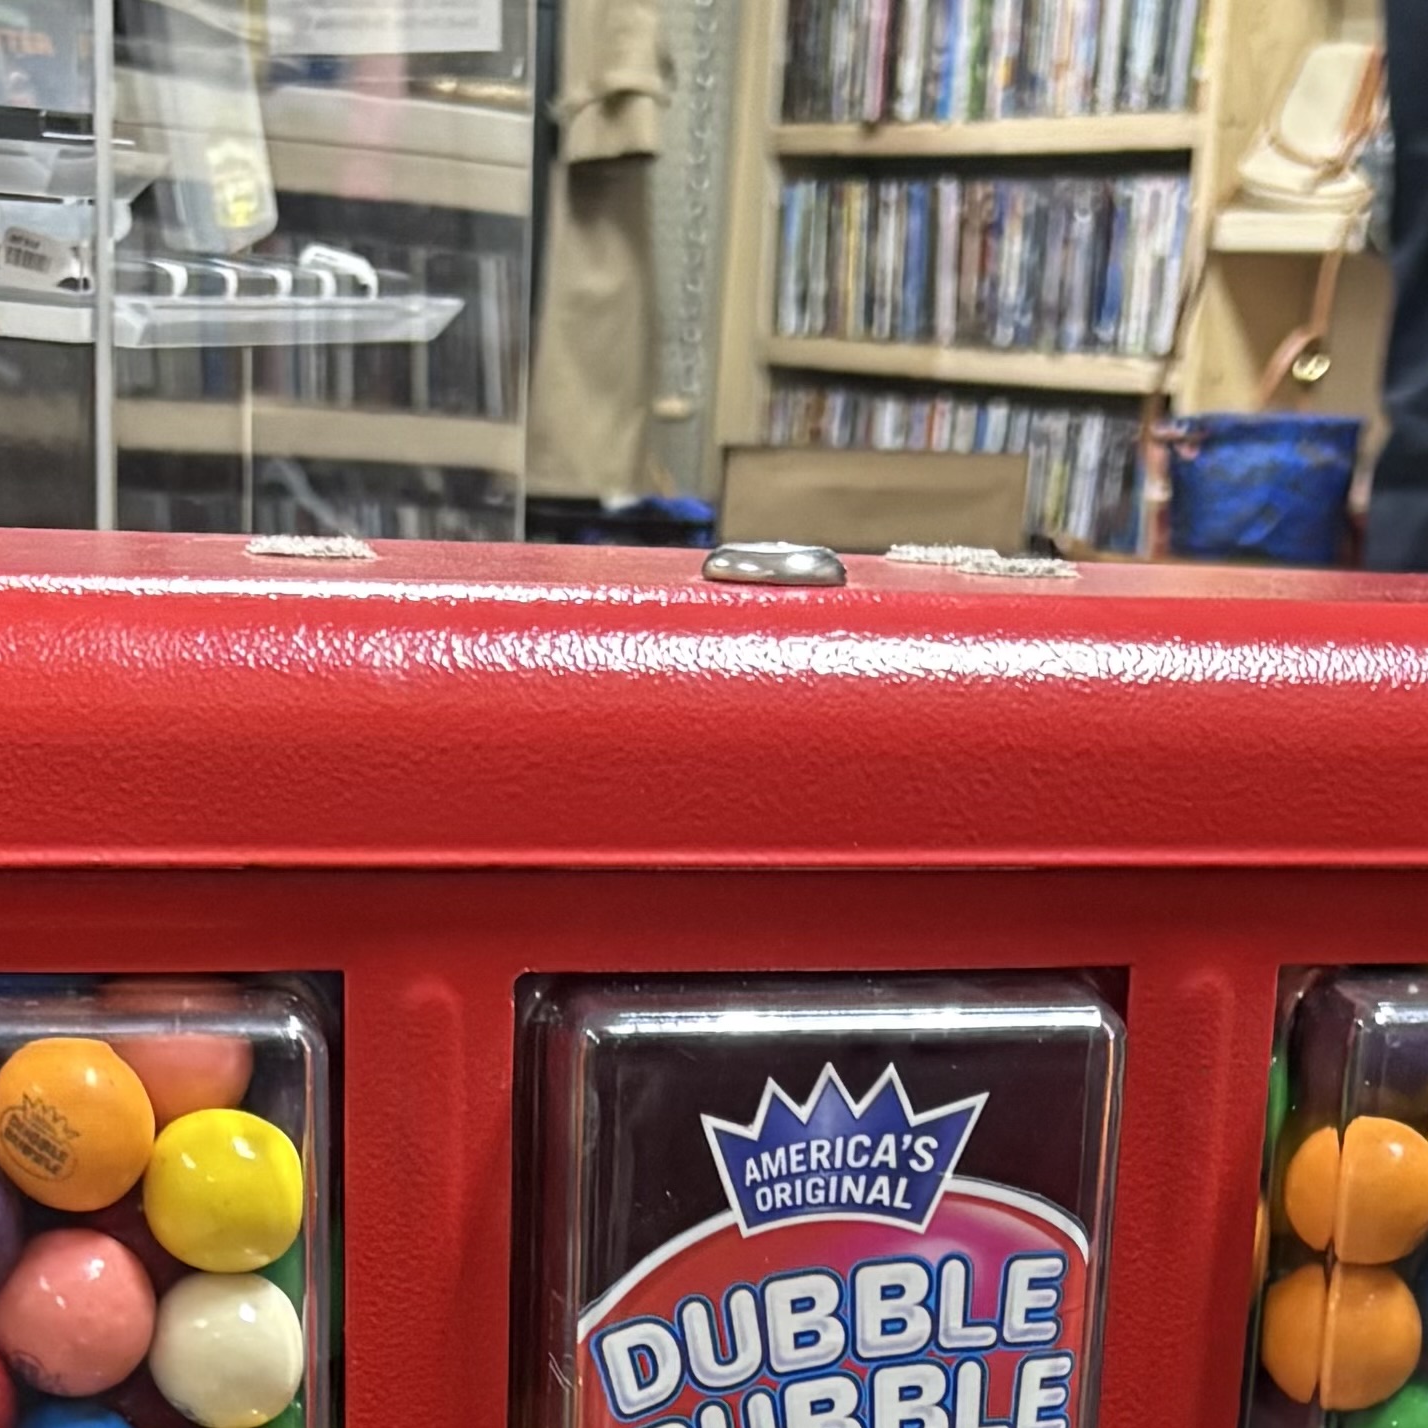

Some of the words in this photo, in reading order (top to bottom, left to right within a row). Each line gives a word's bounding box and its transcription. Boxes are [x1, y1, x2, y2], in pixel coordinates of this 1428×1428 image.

[743, 1132, 939, 1187] AMERICA'S
[754, 1175, 913, 1214] ORIGINAL
[594, 1254, 1068, 1418] DUBBLE
